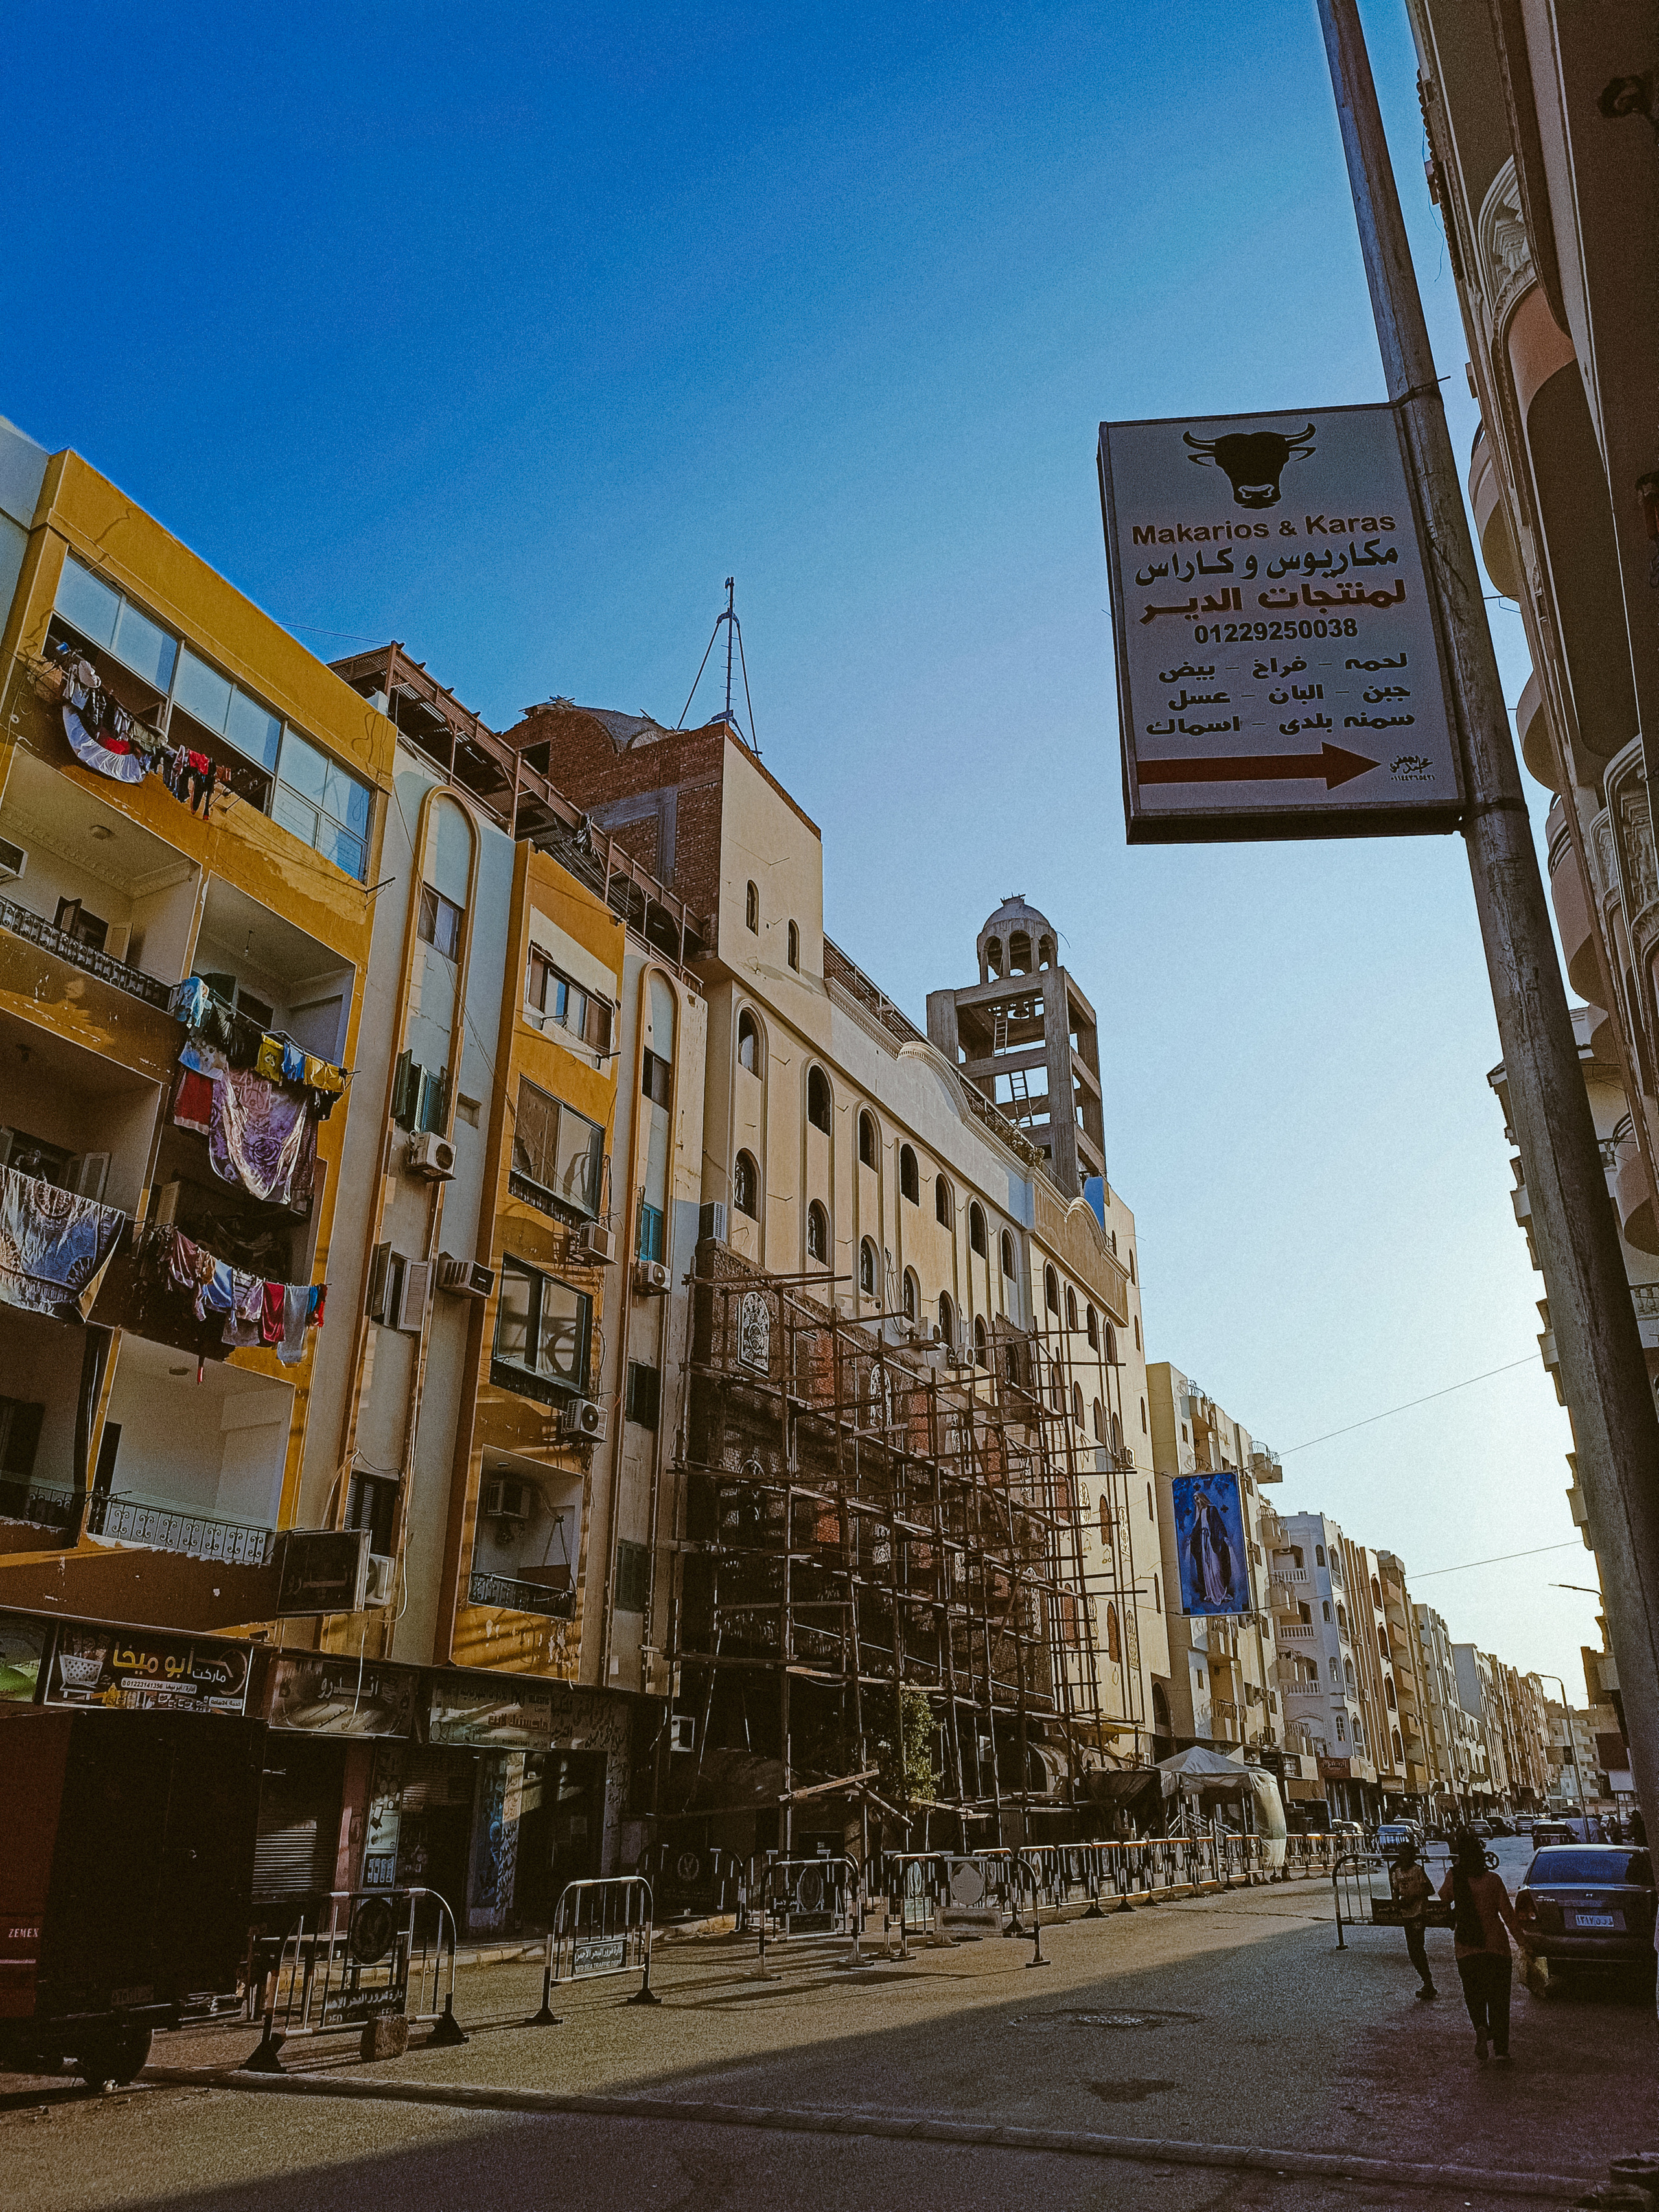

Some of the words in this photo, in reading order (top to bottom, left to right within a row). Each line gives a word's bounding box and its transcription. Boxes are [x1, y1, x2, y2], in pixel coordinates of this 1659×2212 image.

[1131, 518, 1270, 546] Makarios
[1279, 520, 1297, 537] &
[1305, 514, 1397, 535] Karas
[1134, 547, 1233, 587] كاراس
[1240, 553, 1258, 580] و
[1266, 537, 1398, 579] مكاريوس
[1139, 587, 1242, 626] الدير
[1257, 579, 1407, 614] لمنتجات
[1194, 618, 1358, 644] 01229250038
[1158, 662, 1215, 682] بيض
[1251, 656, 1307, 679] فراخ
[1345, 653, 1408, 672] لحمه
[1167, 688, 1231, 711] عسل
[1268, 684, 1323, 705] البان
[1362, 681, 1410, 703] جبن
[1146, 716, 1240, 736] اسماك
[1343, 713, 1415, 729] سمنه
[112, 1642, 159, 1675] ميخا
[165, 1645, 194, 1677] أبو
[192, 1666, 226, 1683] ماركت
[8, 1927, 40, 1938] ZEMEX
[593, 1961, 610, 1969] TRAFFIC
[347, 1990, 367, 2008] البحر
